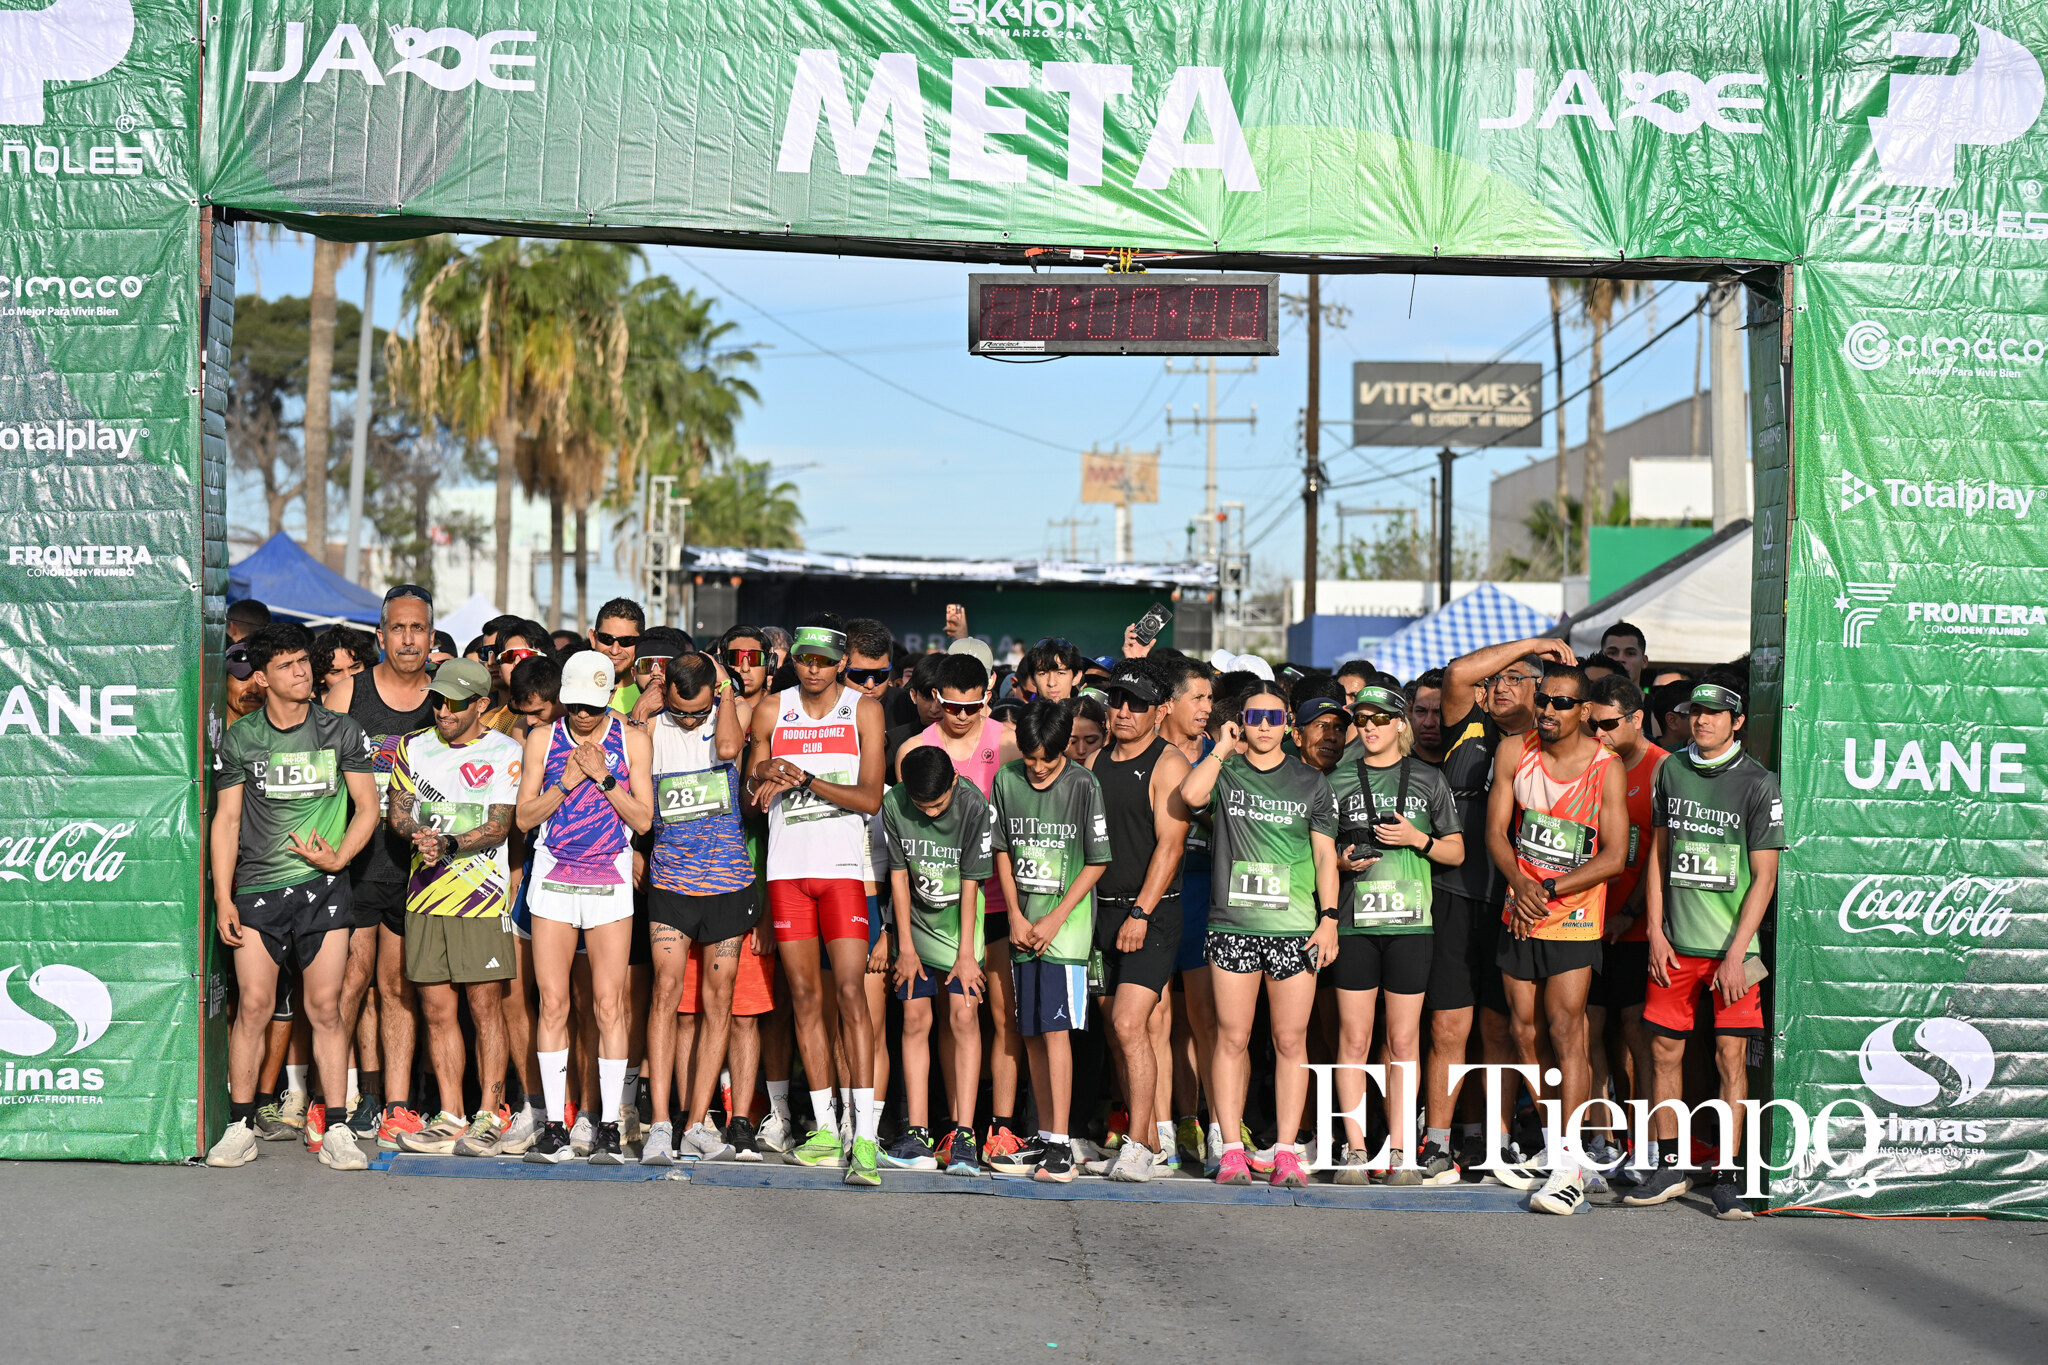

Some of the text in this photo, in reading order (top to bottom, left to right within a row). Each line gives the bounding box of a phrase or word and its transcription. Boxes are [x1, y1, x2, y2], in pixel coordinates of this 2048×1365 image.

[1001, 28, 1050, 38] MARZO
[776, 48, 1260, 192] META
[1855, 204, 2048, 239] PEÑOLES
[2, 306, 119, 317] Lo Mejor Para Vivir Bien
[1897, 335, 2045, 361] cimaco
[1908, 366, 2021, 378] Lo Mejor Para Vivir Bien
[1360, 381, 1533, 409] VITROMEX
[1884, 478, 2035, 518] Totalplay
[9, 545, 153, 565] FRONTERA
[27, 568, 135, 577] CONORDENYRUMBO
[1908, 602, 2047, 625] FRONTERA
[1924, 625, 2029, 636] CONORDENYRUMBO
[0, 685, 138, 736] ANE
[783, 727, 846, 740] RODOLFO GÓMEZ
[802, 742, 823, 753] CLUB
[254, 760, 269, 778] E
[275, 764, 317, 785] 150
[327, 759, 336, 791] MEDALLA
[1845, 738, 2027, 793] UANE
[666, 785, 709, 809] 287
[719, 781, 729, 809] MEDALLA
[789, 790, 825, 810] 22
[1229, 789, 1308, 818] El Tiempo
[1348, 794, 1365, 811] El
[1228, 806, 1293, 825] de todos
[1349, 812, 1368, 821] de
[1668, 797, 1741, 829] El Tiempo
[429, 815, 457, 833] 27
[1009, 817, 1077, 839] El Tiempo
[1668, 818, 1725, 836] de todos
[1012, 837, 1066, 848] de todos
[1530, 824, 1567, 850] 146
[1629, 833, 1637, 862] MEDALLA
[900, 839, 962, 863] El Tiemp
[1575, 834, 1584, 864] MEDALLA
[1016, 858, 1053, 879] 236
[1677, 853, 1719, 875] 314
[1729, 854, 1737, 886] MEDALLA
[919, 876, 944, 896] 22
[1240, 874, 1281, 895] 118
[1362, 892, 1405, 912] 218
[1838, 874, 2024, 937] Coca-Cola
[0, 1062, 105, 1090] imas
[0, 1095, 103, 1105] CLOVA-FRONTERA
[1863, 1147, 1986, 1157] NCLOVA-FRONTERA
